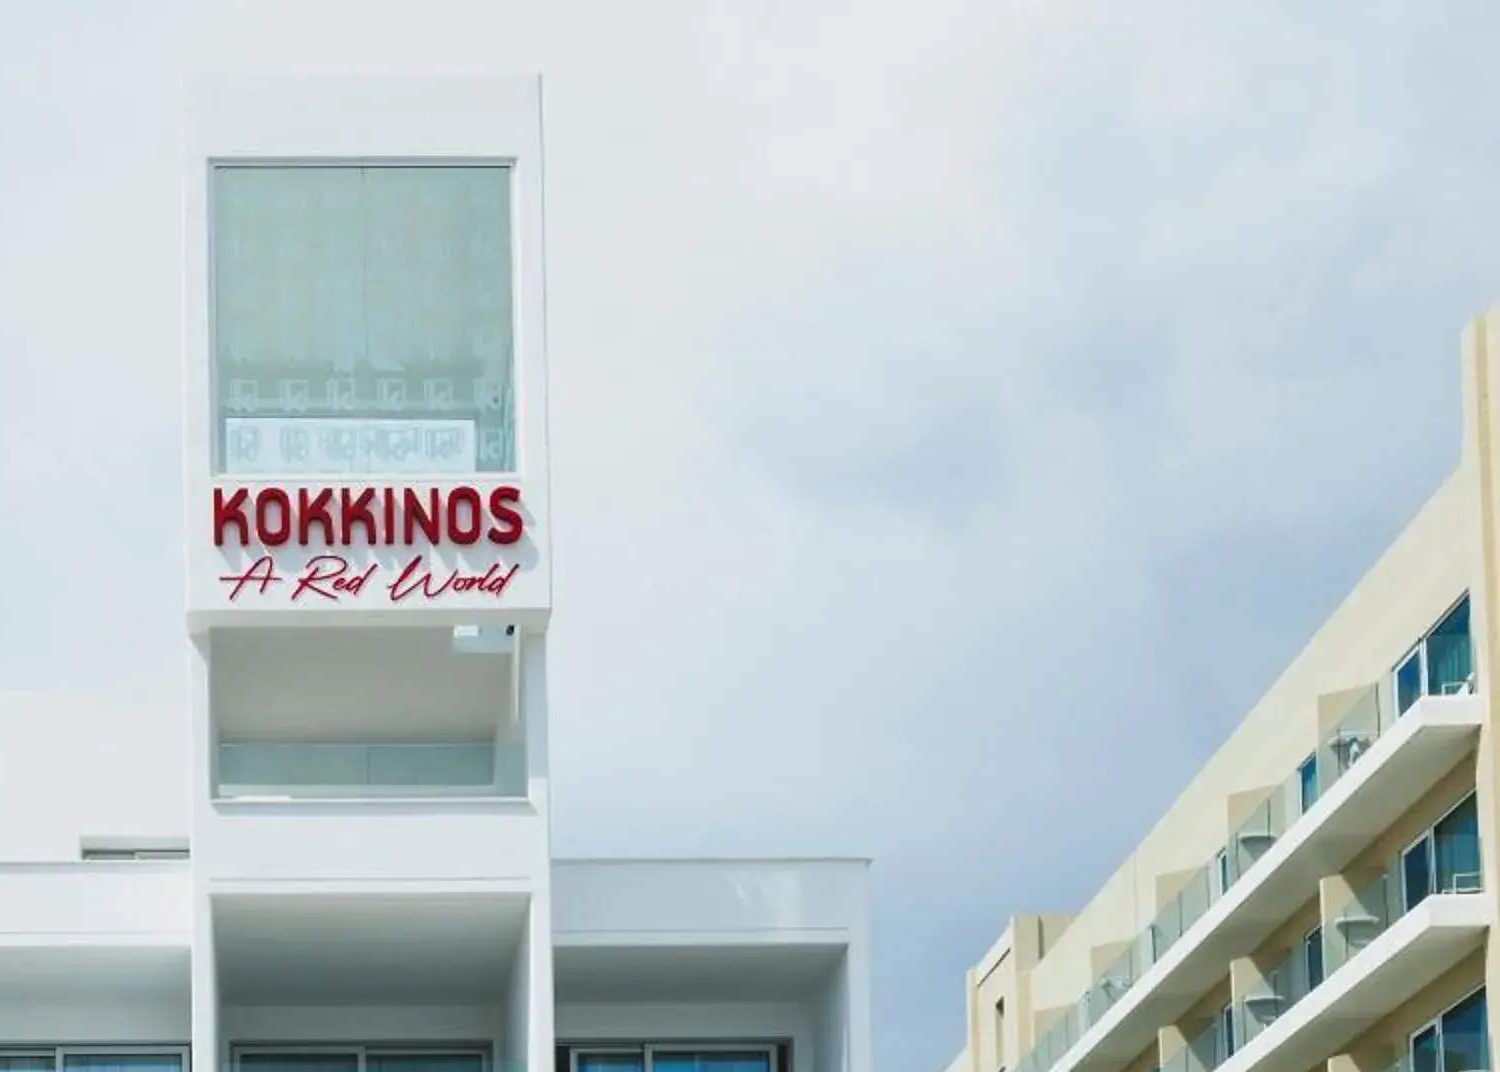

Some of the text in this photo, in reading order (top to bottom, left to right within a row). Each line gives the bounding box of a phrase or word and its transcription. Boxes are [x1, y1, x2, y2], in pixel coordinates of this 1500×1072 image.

[213, 486, 524, 546] KOKKINOS
[219, 554, 521, 601] A Red World
